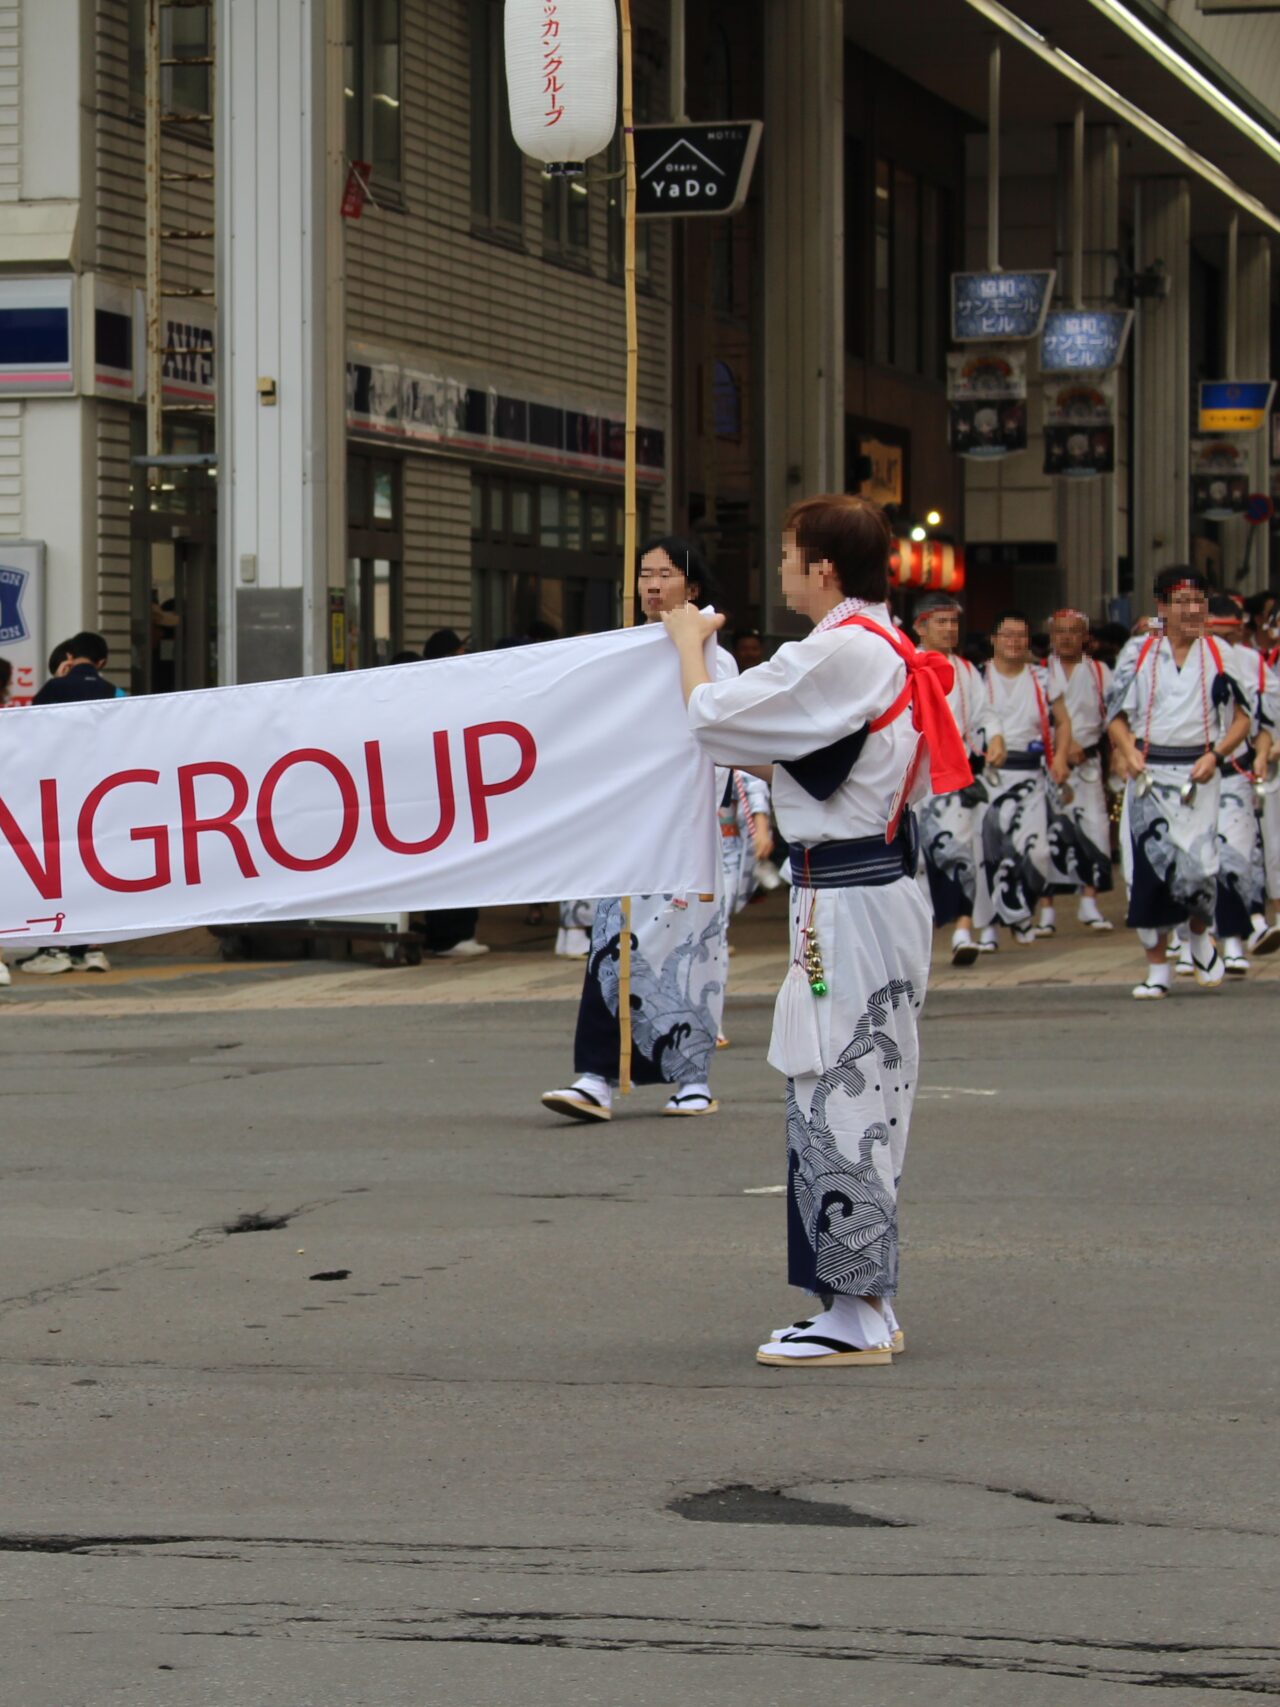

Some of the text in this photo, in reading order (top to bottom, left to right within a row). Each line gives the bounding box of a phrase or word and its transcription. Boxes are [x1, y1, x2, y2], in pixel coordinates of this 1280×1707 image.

[540, 0, 566, 127] ッカングループ
[665, 163, 698, 173] Otaru
[651, 180, 718, 198] YaDo
[957, 299, 1039, 316] サンモール
